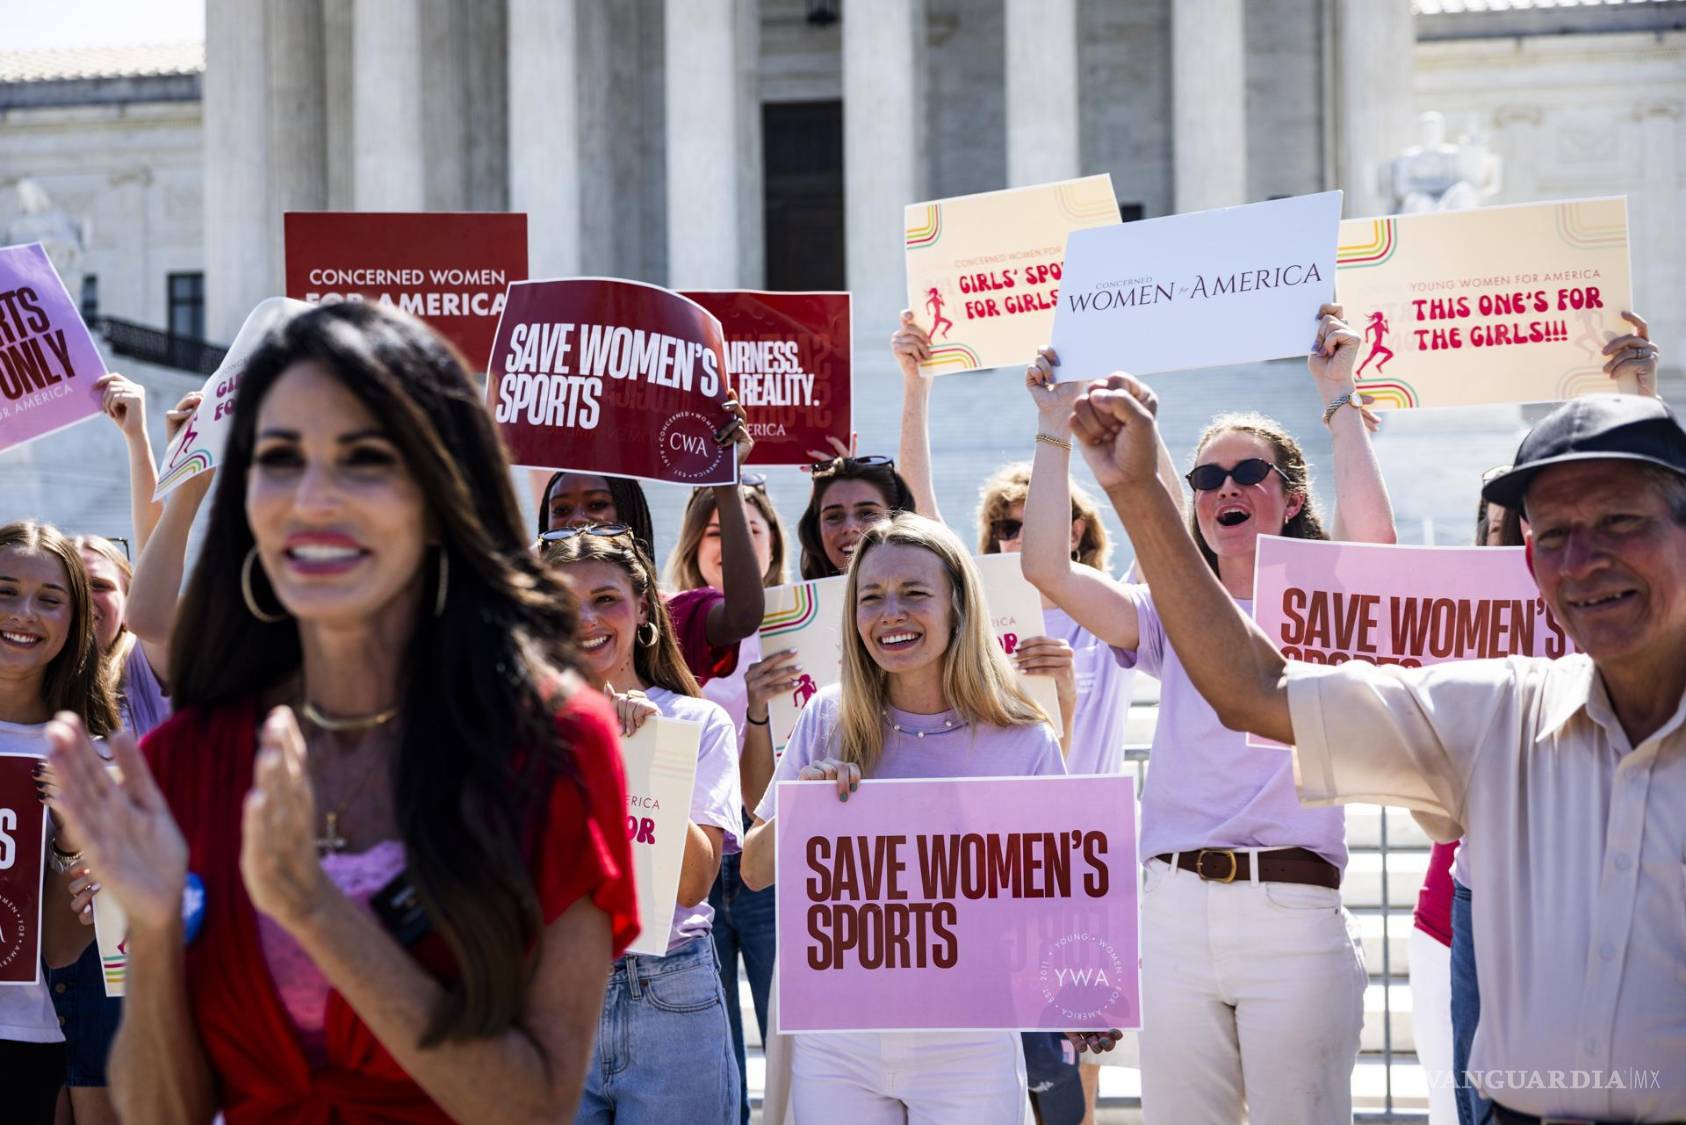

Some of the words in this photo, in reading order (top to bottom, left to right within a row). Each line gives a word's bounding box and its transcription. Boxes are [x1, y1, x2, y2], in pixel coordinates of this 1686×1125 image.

[309, 269, 424, 285] CONCERNED
[429, 269, 505, 285] WOMEN
[960, 269, 1018, 294] GIRLS'
[1025, 262, 1064, 285] SPO
[1069, 281, 1175, 313] WOMEN
[1190, 263, 1323, 299] AMERICA
[1096, 277, 1153, 290] CONCERNED
[1410, 280, 1455, 292] YOUNG
[1460, 276, 1511, 288] WOMEN
[1515, 274, 1539, 285] FOR
[1544, 269, 1601, 282] AMERICA
[965, 299, 1001, 319] FOR
[1412, 297, 1471, 321] THIS
[1478, 290, 1549, 316] ONE'S
[1557, 286, 1604, 311] FOR
[1414, 327, 1462, 351] THE
[1470, 320, 1568, 347] GIRLS!!!
[505, 323, 575, 374] SAVE
[579, 324, 719, 397] WOMEN'S
[15, 383, 73, 414] AMERICA
[495, 373, 602, 430] SPORTS
[739, 374, 820, 406] REALITY.
[670, 432, 709, 458] CWA
[1281, 588, 1380, 653] SAVE
[806, 835, 907, 902] SAVE
[916, 830, 1109, 900] WOMEN'S
[807, 902, 958, 971] SPORTS
[1055, 933, 1088, 949] YOUNG
[1055, 968, 1109, 987] YWA
